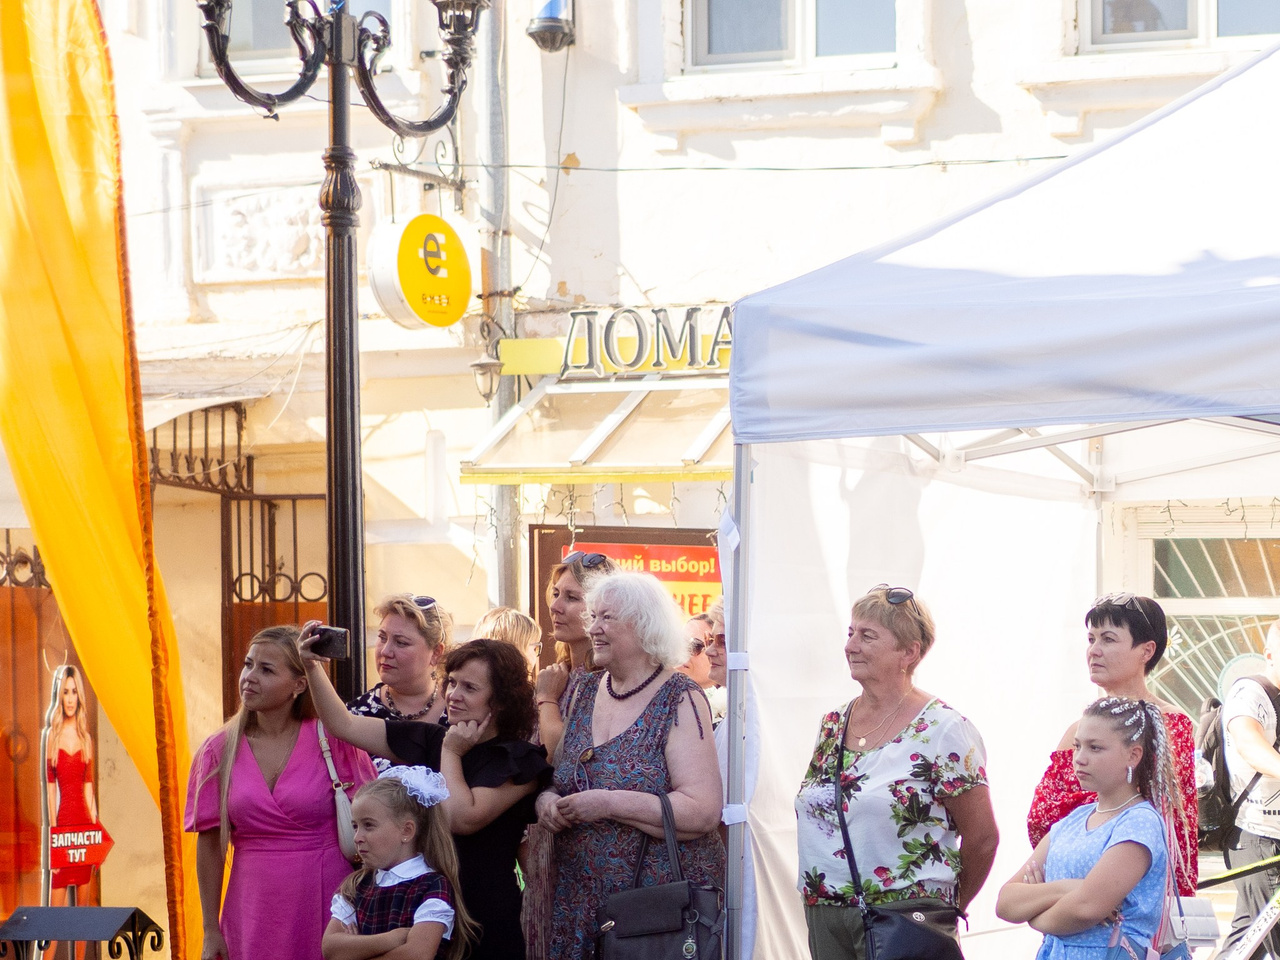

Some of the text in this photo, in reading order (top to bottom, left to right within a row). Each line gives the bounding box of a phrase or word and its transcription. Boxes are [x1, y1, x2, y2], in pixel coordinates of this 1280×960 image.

[650, 555, 715, 577] выбор!
[51, 830, 102, 848] ЗАПЧАСТИ
[68, 848, 87, 863] ТУТ
